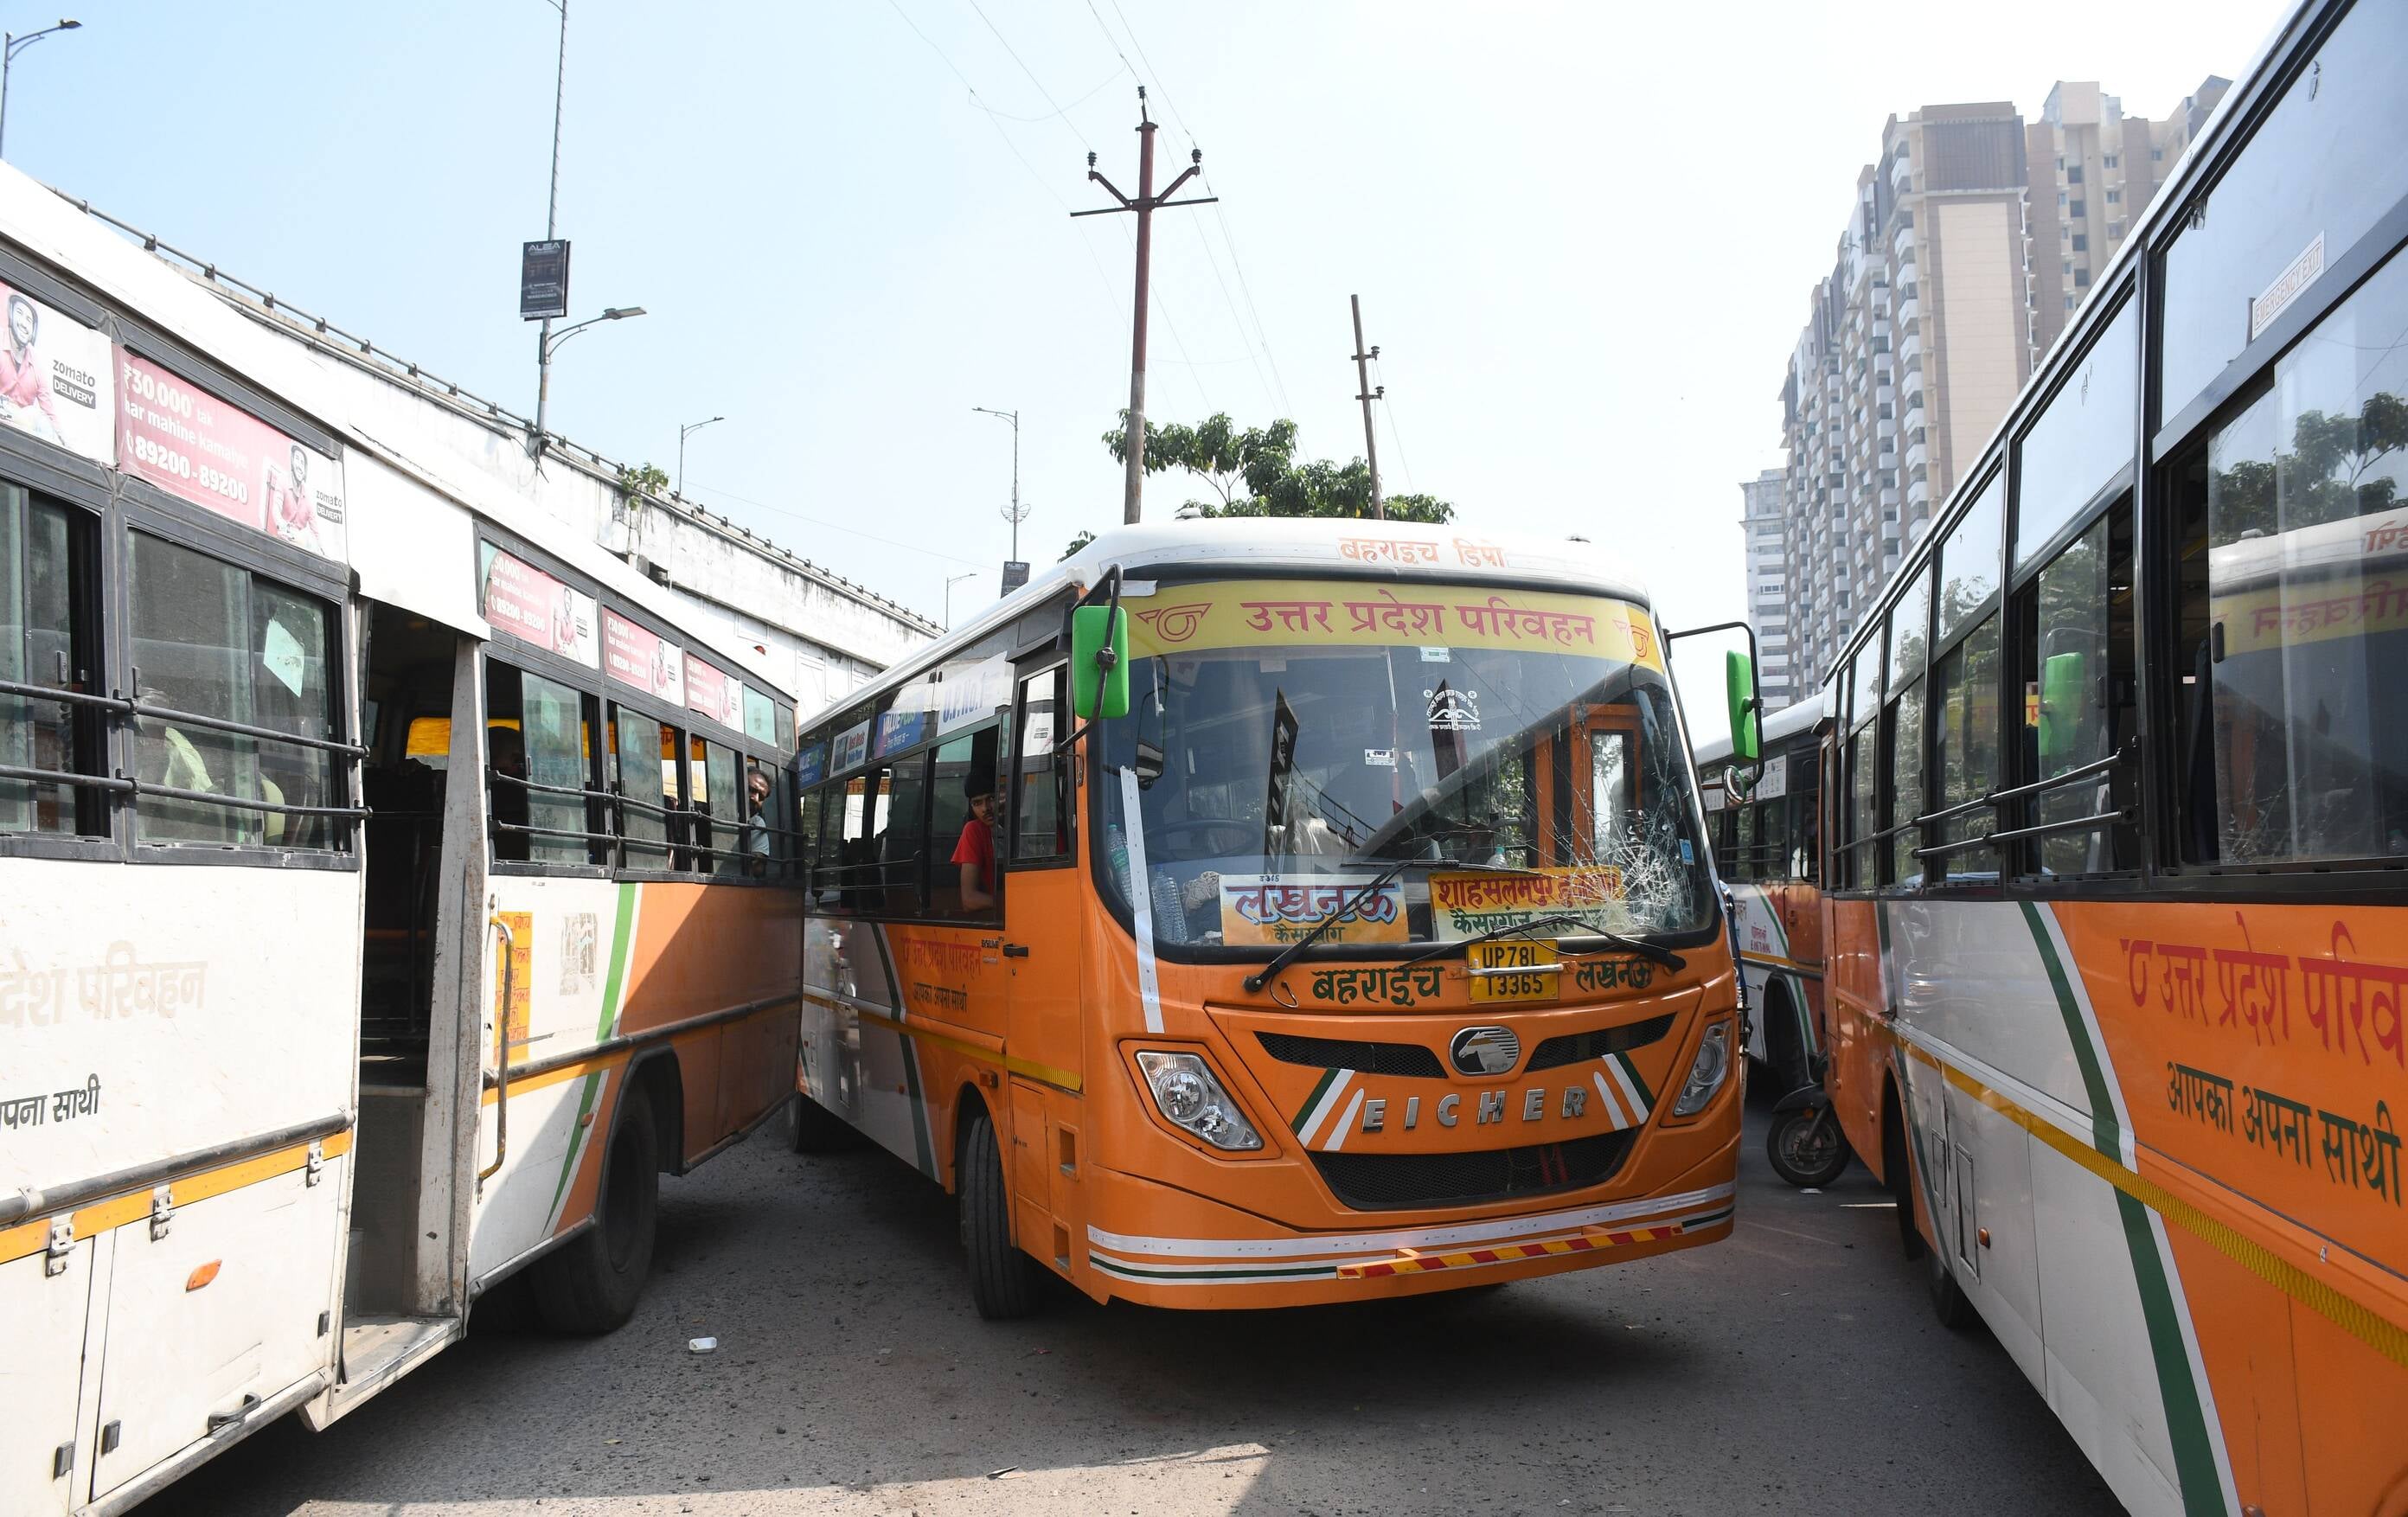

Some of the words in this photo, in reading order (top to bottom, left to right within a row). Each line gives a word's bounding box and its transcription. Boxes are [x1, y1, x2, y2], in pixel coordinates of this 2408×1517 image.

[2255, 266, 2302, 326] EMERGENCY
[2302, 246, 2321, 280] EXIT
[53, 359, 95, 387] zomato
[54, 379, 93, 405] DELIVERY
[125, 394, 145, 421] har
[148, 408, 196, 445] mahine
[197, 408, 214, 426] tak
[317, 490, 343, 508] zomato
[1337, 537, 1439, 565] बहराइच
[1452, 536, 1507, 568] डिपो
[1239, 599, 1333, 635] उत्तर
[1342, 589, 1447, 639] प्रदेश
[1454, 596, 1595, 648] परिवहन
[1225, 882, 1401, 925] लखनऊ
[1482, 945, 1543, 969] UP78L
[1575, 957, 1656, 993] लखनऊ
[0, 946, 67, 1027] देश
[76, 939, 208, 1020] परिवहन
[1310, 964, 1446, 1007] बहराइच
[1486, 973, 1544, 996] T3365
[2155, 942, 2210, 1027] उत्तर
[2212, 911, 2291, 1047] प्रदेश
[2297, 920, 2408, 1071] परिव
[0, 1095, 48, 1130] पना
[53, 1072, 101, 1123] साथी
[1361, 1085, 1589, 1134] EICHER
[2166, 1060, 2235, 1137] आपका
[2242, 1085, 2312, 1170] अपना
[2316, 1099, 2403, 1208] साथी
